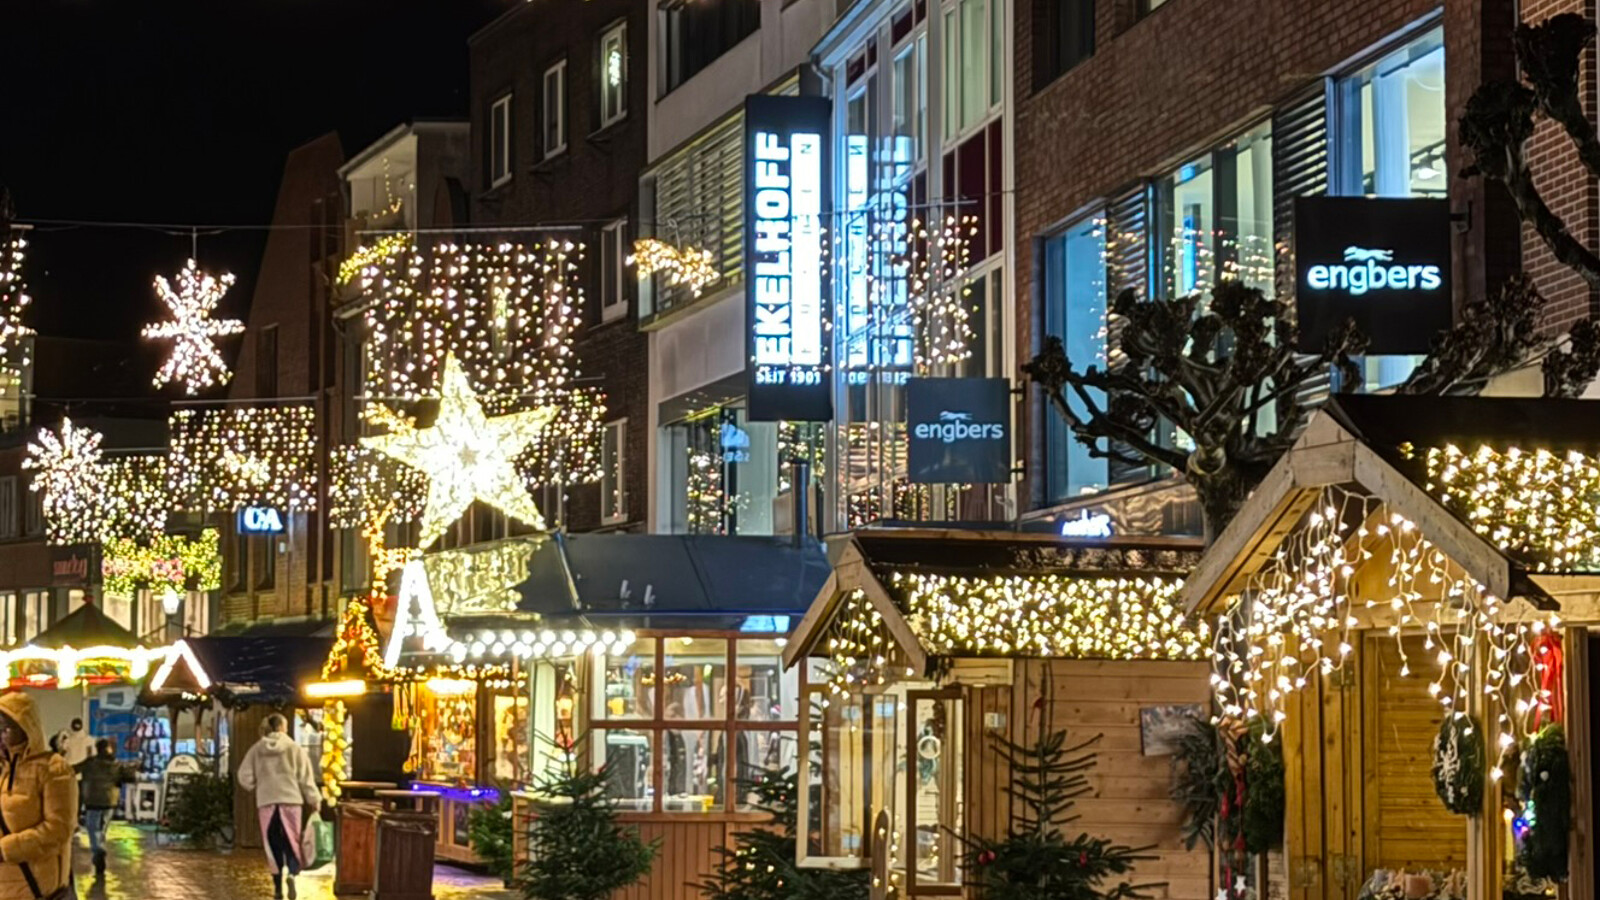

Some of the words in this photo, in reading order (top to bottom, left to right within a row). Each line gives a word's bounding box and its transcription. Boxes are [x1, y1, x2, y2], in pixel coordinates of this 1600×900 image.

[755, 131, 790, 366] EKELHOFF
[1307, 258, 1442, 296] engbers
[790, 369, 822, 386] 1901
[914, 419, 1004, 443] engbers
